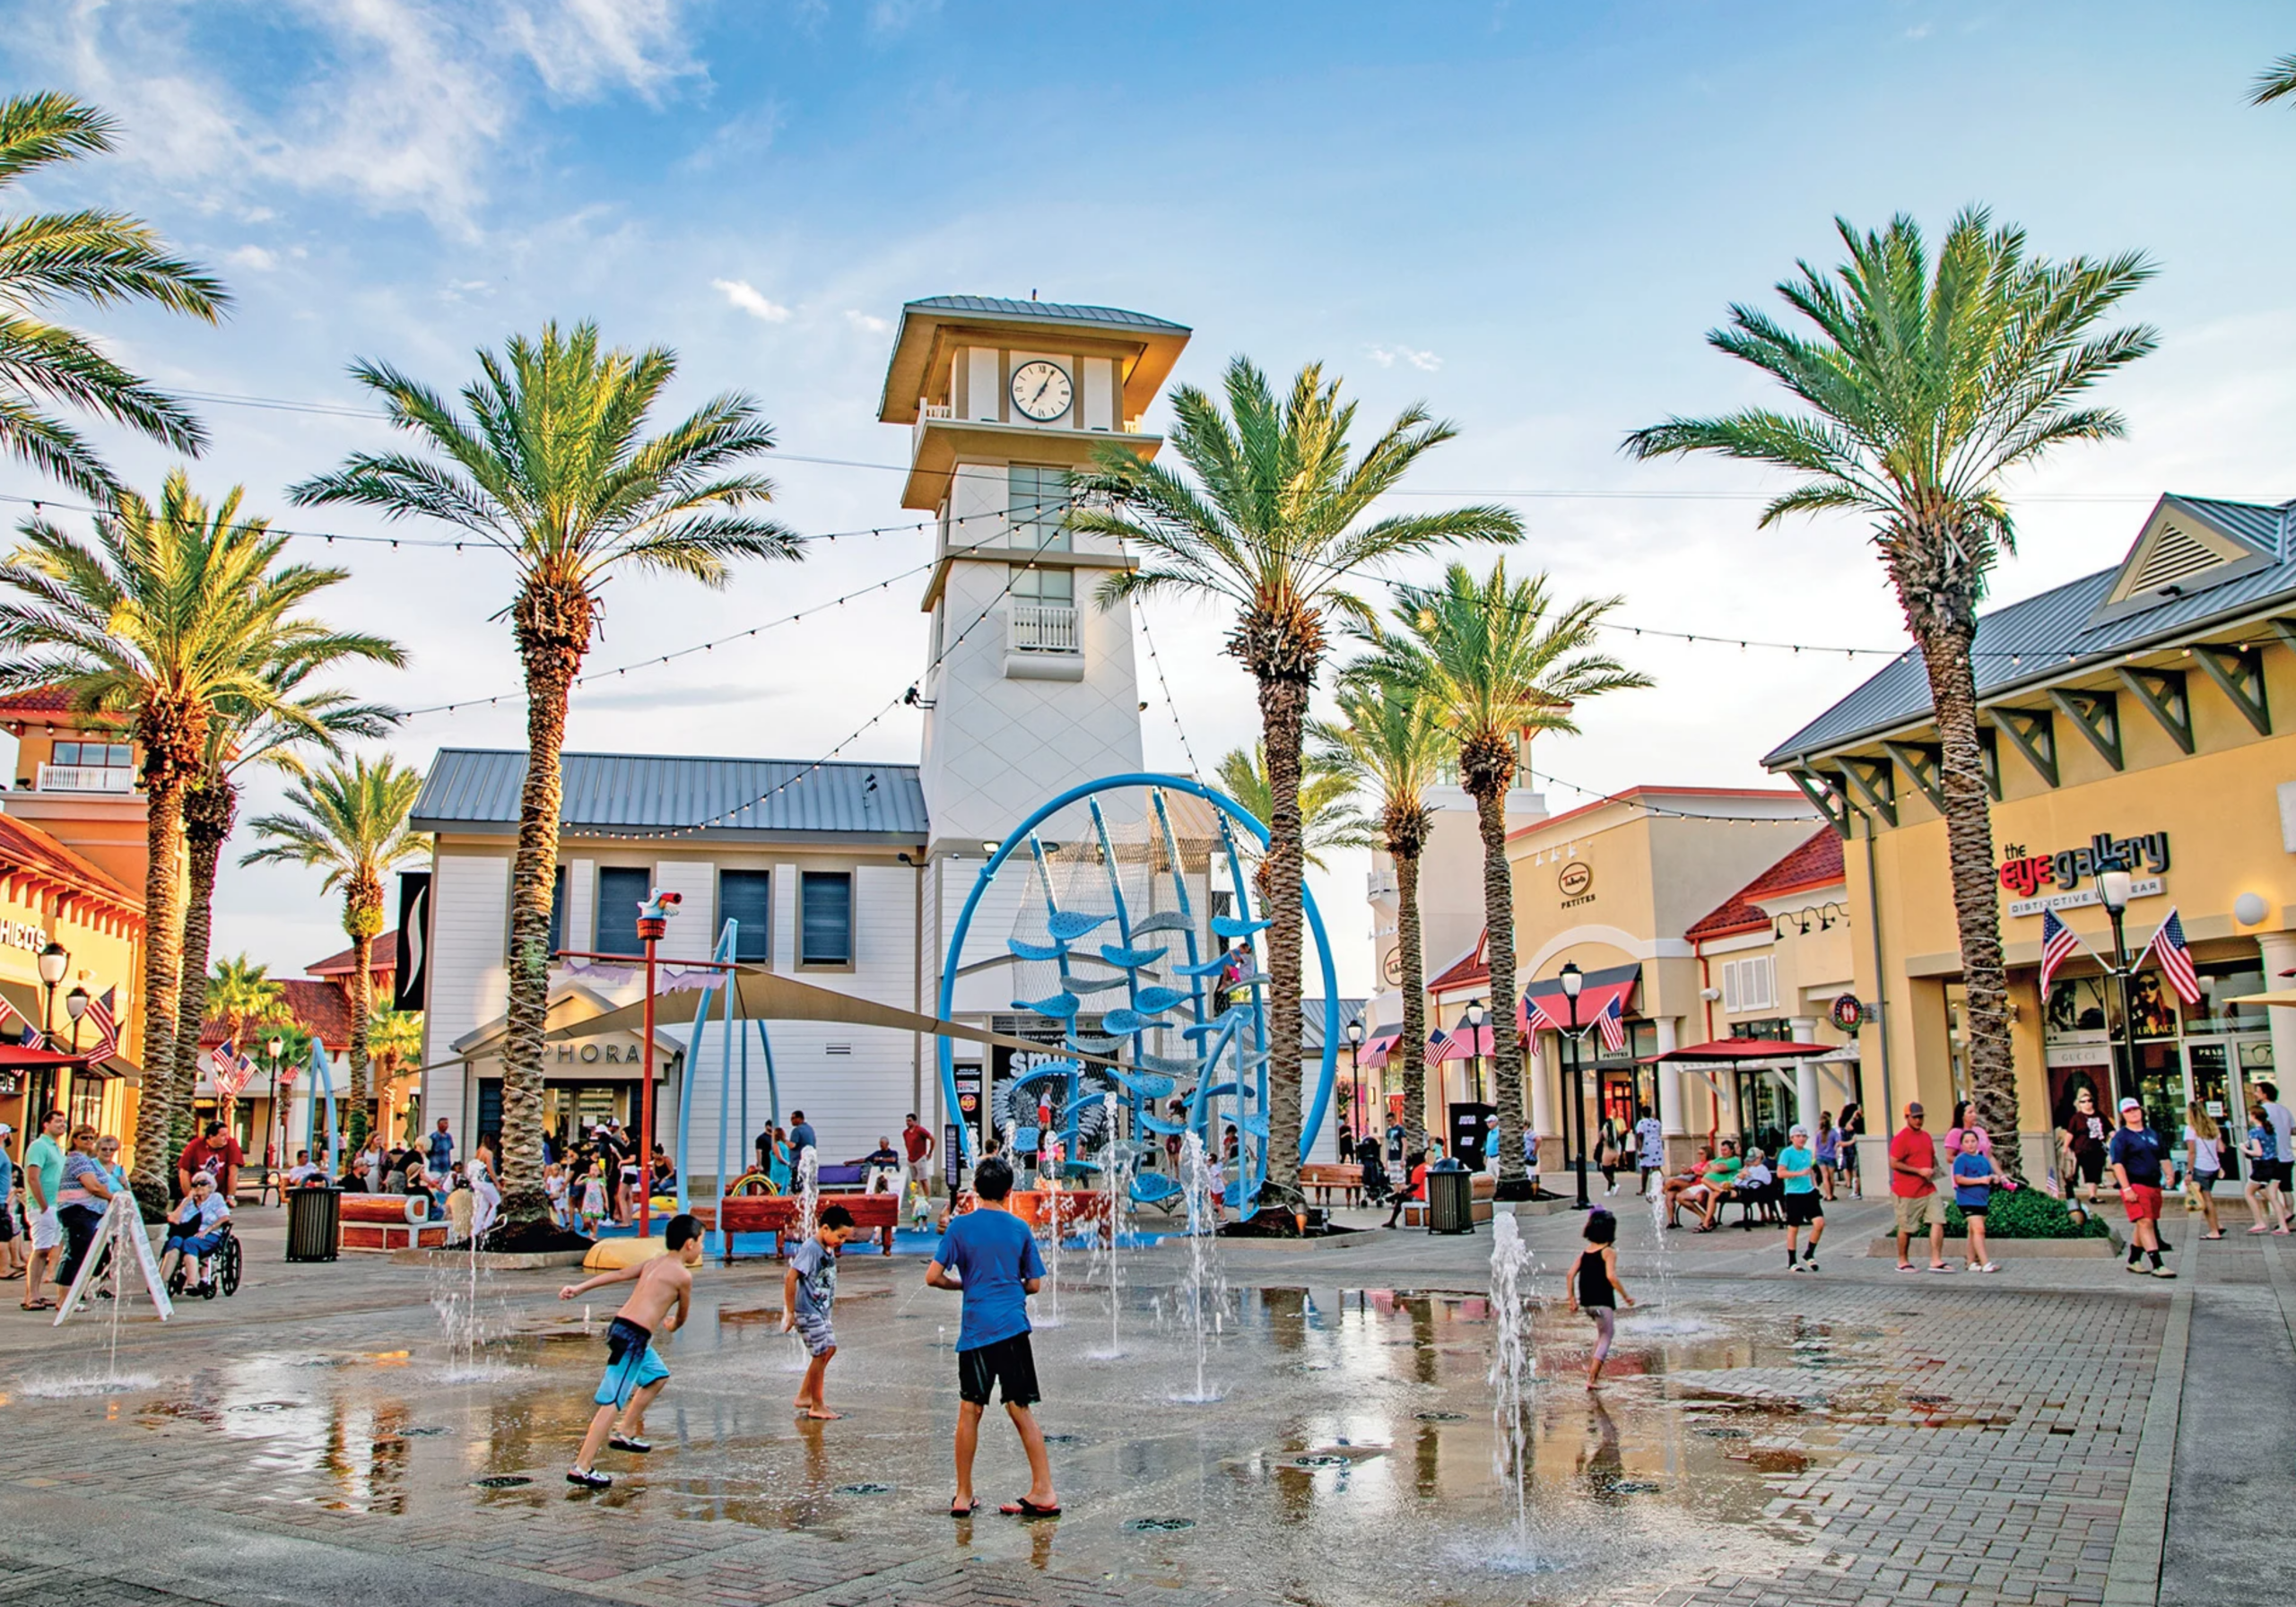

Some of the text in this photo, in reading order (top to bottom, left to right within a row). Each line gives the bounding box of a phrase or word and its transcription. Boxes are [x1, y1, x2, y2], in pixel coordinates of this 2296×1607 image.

[2005, 843, 2026, 861] the
[1561, 893, 1596, 909] PETITES
[2133, 1024, 2178, 1035] ERACE
[499, 1043, 640, 1064] PHORA
[2061, 1052, 2096, 1062] GUCCI
[2198, 1048, 2224, 1056] PRAD
